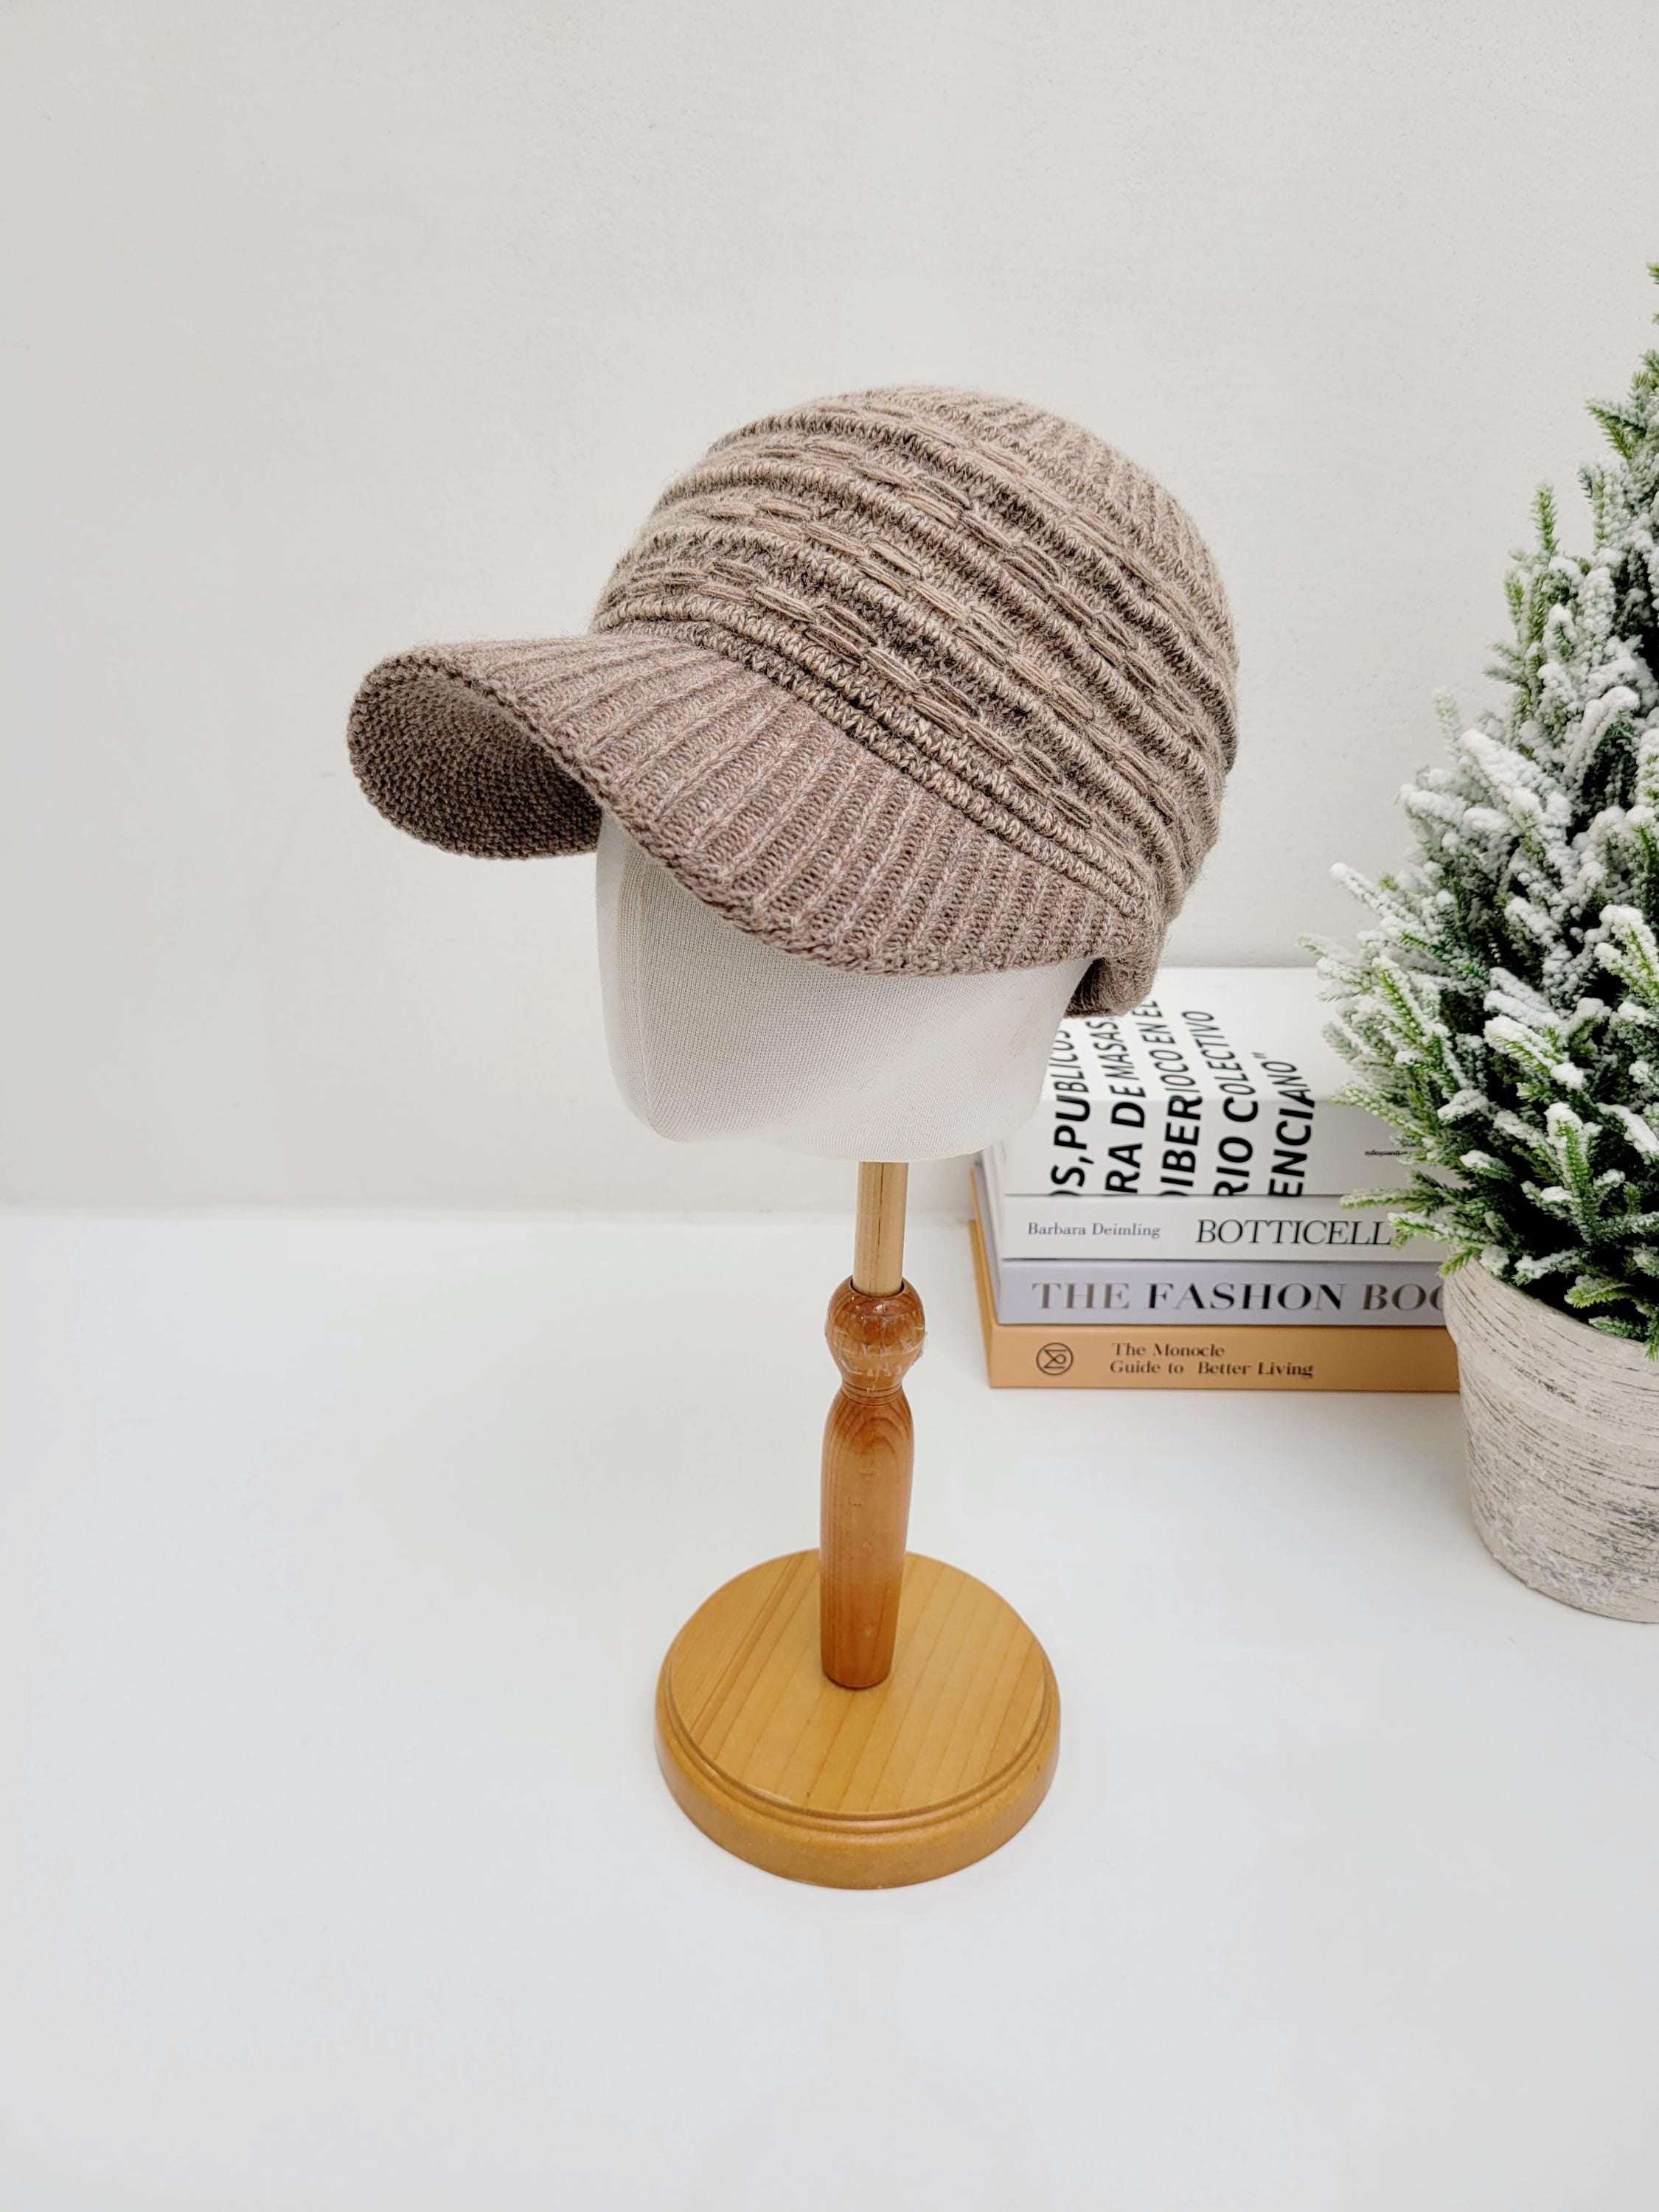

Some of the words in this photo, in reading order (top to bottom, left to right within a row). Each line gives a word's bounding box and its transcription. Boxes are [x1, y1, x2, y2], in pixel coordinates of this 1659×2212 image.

[1131, 1001, 1163, 1018] EL
[1135, 1022, 1175, 1044] EN
[1181, 1011, 1259, 1122] COLECTIVO
[1109, 1085, 1146, 1128] DE
[1158, 1049, 1203, 1196] IBERIOCO
[1212, 1136, 1253, 1196] RIO
[1028, 1222, 1086, 1235] Barbara
[1092, 1222, 1161, 1239] Deimling
[1195, 1219, 1391, 1245] BOTTICELL
[1032, 1282, 1130, 1309] THE
[1112, 1343, 1146, 1355] The
[1153, 1343, 1225, 1357] Monocle
[1110, 1360, 1160, 1373] Guide
[1168, 1362, 1183, 1374] to
[1198, 1361, 1251, 1374] Better
[1258, 1362, 1313, 1377] Living
